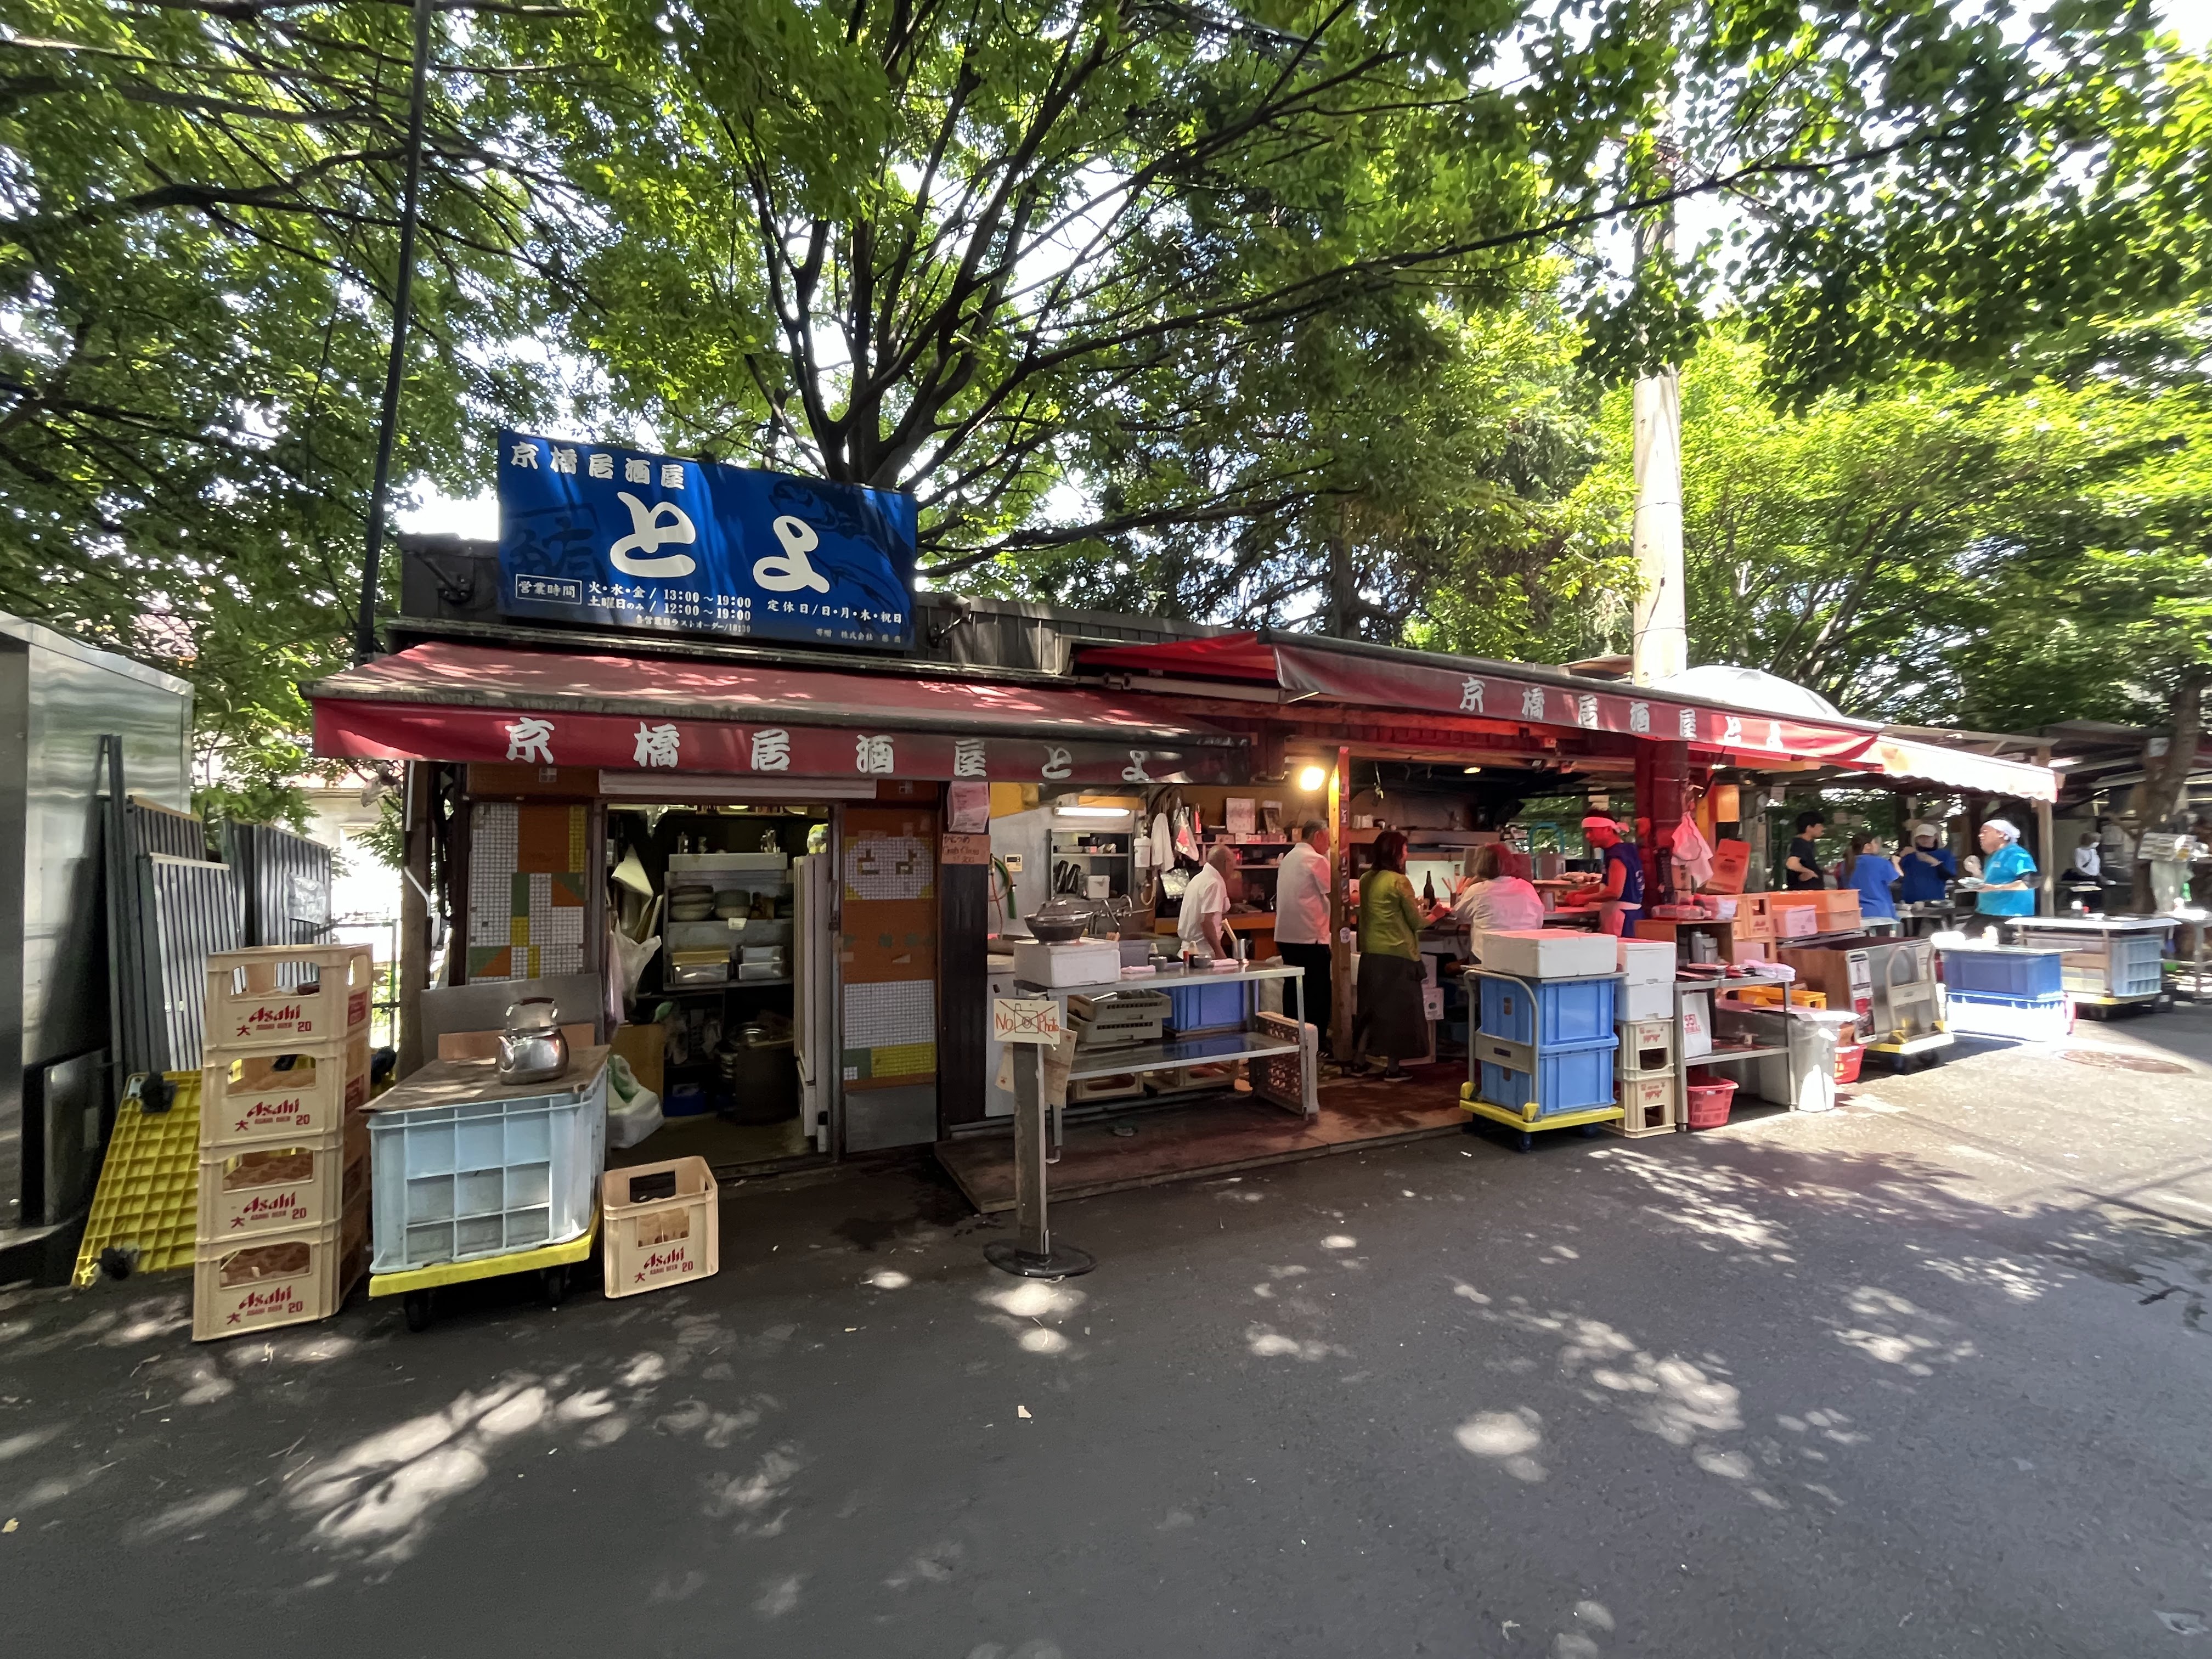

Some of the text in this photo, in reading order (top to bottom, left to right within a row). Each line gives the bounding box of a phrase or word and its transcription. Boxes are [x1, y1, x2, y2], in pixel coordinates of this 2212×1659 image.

[511, 441, 685, 490] 京橋居酒屋
[610, 492, 830, 594] とよ
[518, 580, 575, 599] 営業時間
[249, 1004, 301, 1023] Asahi
[995, 1013, 1060, 1033] No Photo
[297, 1020, 312, 1032] 20
[247, 1098, 300, 1119] Asahi
[296, 1114, 311, 1126] 20
[242, 1191, 296, 1214] Asahi
[292, 1207, 307, 1220] 20
[644, 1245, 685, 1271] Asahi
[682, 1261, 694, 1273] 20
[634, 1272, 646, 1284] 大
[238, 1285, 292, 1310] Asahi
[288, 1300, 303, 1314] 20
